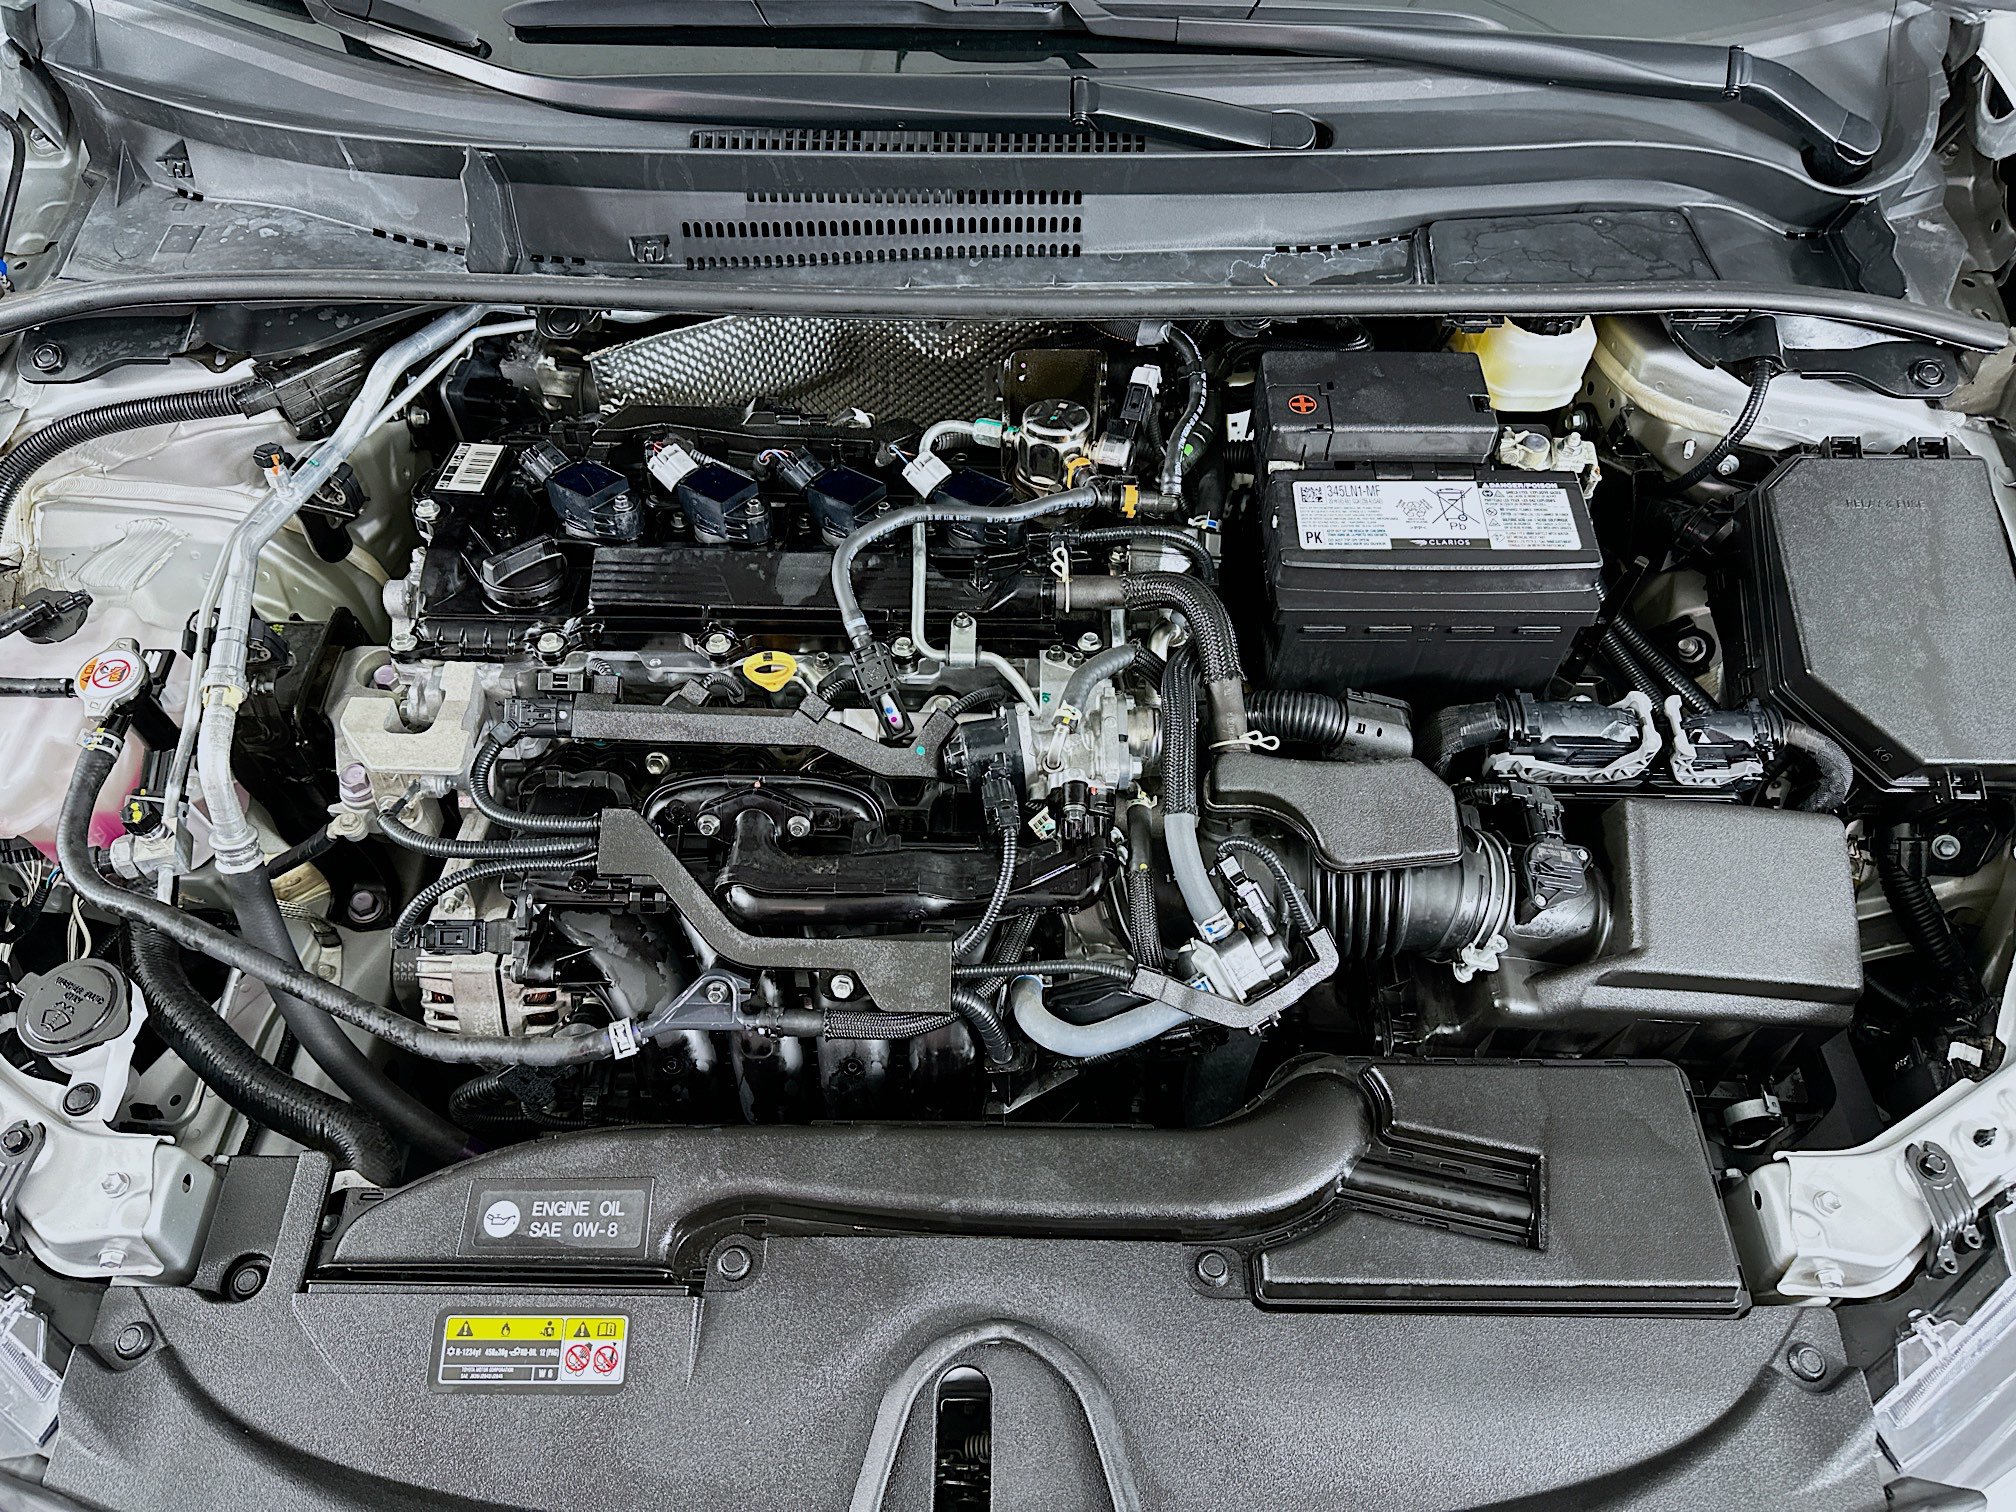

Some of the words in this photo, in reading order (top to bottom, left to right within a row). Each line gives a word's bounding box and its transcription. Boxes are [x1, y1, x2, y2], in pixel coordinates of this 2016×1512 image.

[1326, 485, 1381, 497] 345LN1-MF
[1449, 521, 1467, 531] Pb
[1305, 531, 1323, 544] PK
[531, 1200, 591, 1217] ENGINE
[599, 1200, 625, 1217] OIL
[528, 1221, 563, 1238] SAE
[572, 1221, 618, 1238] 0W-8
